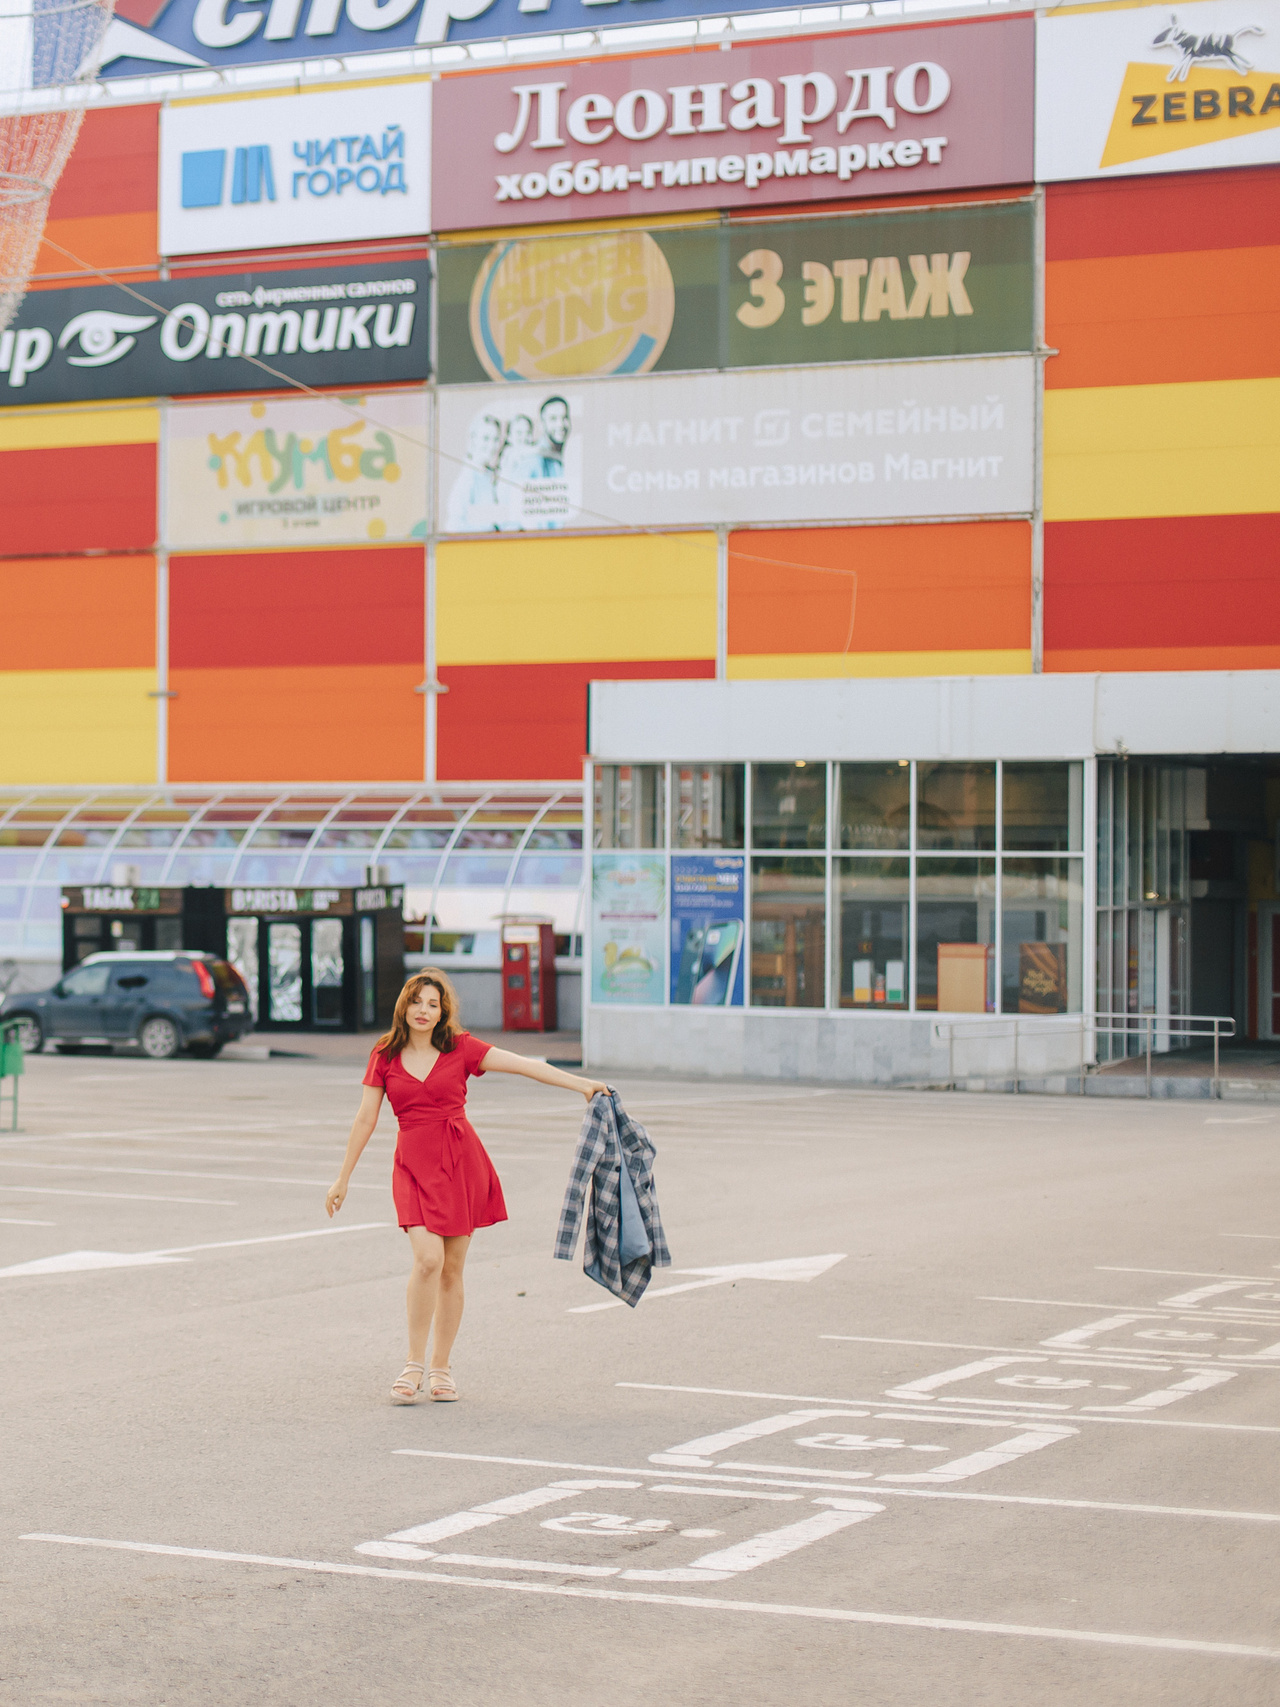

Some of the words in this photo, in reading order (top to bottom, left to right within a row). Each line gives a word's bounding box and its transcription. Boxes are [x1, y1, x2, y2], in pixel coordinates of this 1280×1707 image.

[494, 61, 951, 153] Леонардо
[1131, 82, 1280, 126] ZEBRA
[292, 124, 405, 167] ЧИТАЙ
[495, 136, 948, 201] хобби-гипермаркет
[292, 162, 408, 199] ГОРОД
[346, 278, 417, 298] салонов
[736, 248, 786, 329] 3
[159, 301, 416, 362] Оптики
[504, 274, 648, 373] KING
[606, 416, 745, 448] МАГНИТ
[800, 396, 1005, 439] СЕМЕЙНЫЙ
[606, 464, 700, 494] Семья
[708, 461, 875, 489] магазинов
[883, 453, 1004, 483] Магнит
